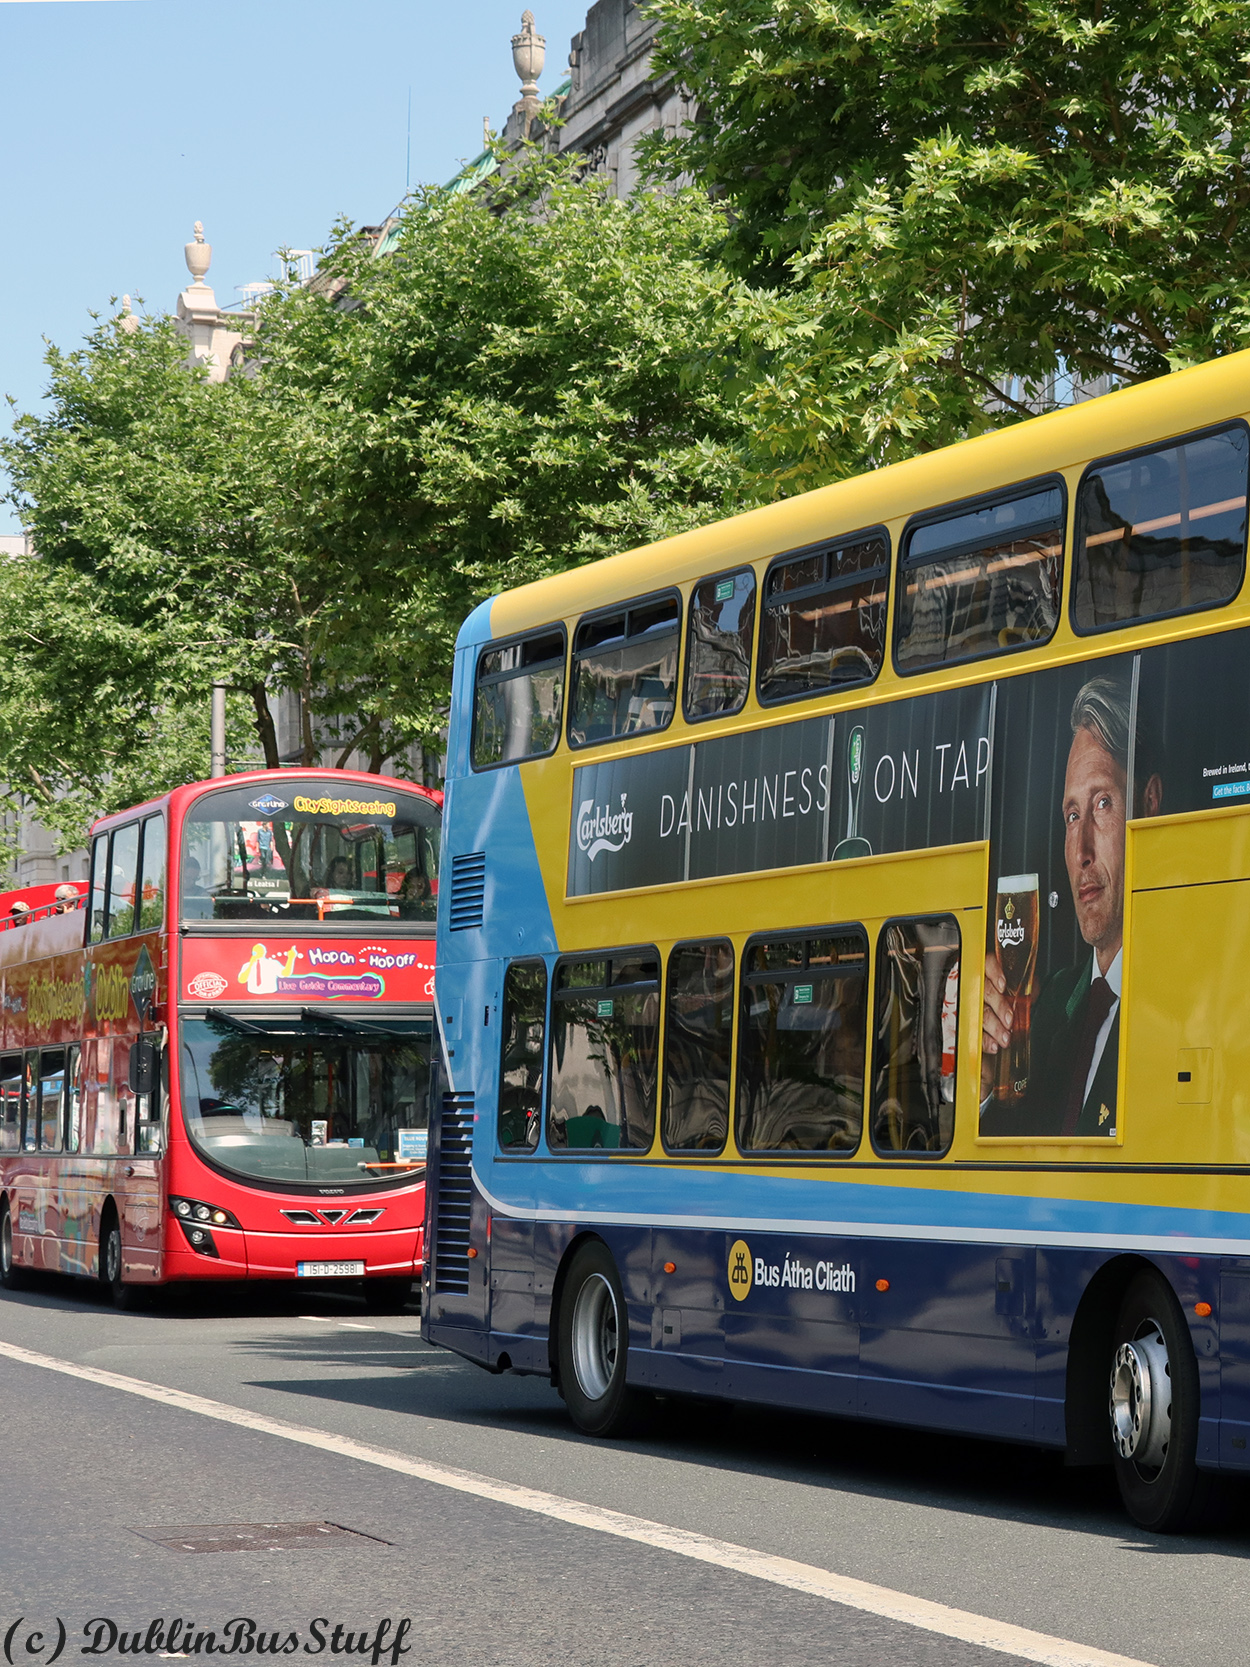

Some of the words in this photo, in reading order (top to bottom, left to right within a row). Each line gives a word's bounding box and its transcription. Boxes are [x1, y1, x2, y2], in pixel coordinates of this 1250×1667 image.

[875, 750, 919, 803] ON
[935, 737, 990, 793] TAP
[1203, 767, 1221, 777] Brewed
[1222, 765, 1227, 774] in
[1228, 762, 1247, 773] Ireland,
[661, 764, 830, 839] DANISHNESS
[1213, 787, 1223, 796] Get
[1223, 785, 1232, 795] the
[294, 796, 397, 818] CitySightseeing
[577, 796, 633, 861] Carlsberg
[997, 919, 1024, 948] Carlsberg
[278, 980, 297, 991] Live
[299, 980, 325, 991] Guide
[327, 980, 381, 992] Commentary
[310, 1264, 358, 1274] 151-D-25981
[755, 1258, 780, 1287] Bus
[781, 1252, 813, 1290] Átha
[816, 1261, 856, 1293] Cliath
